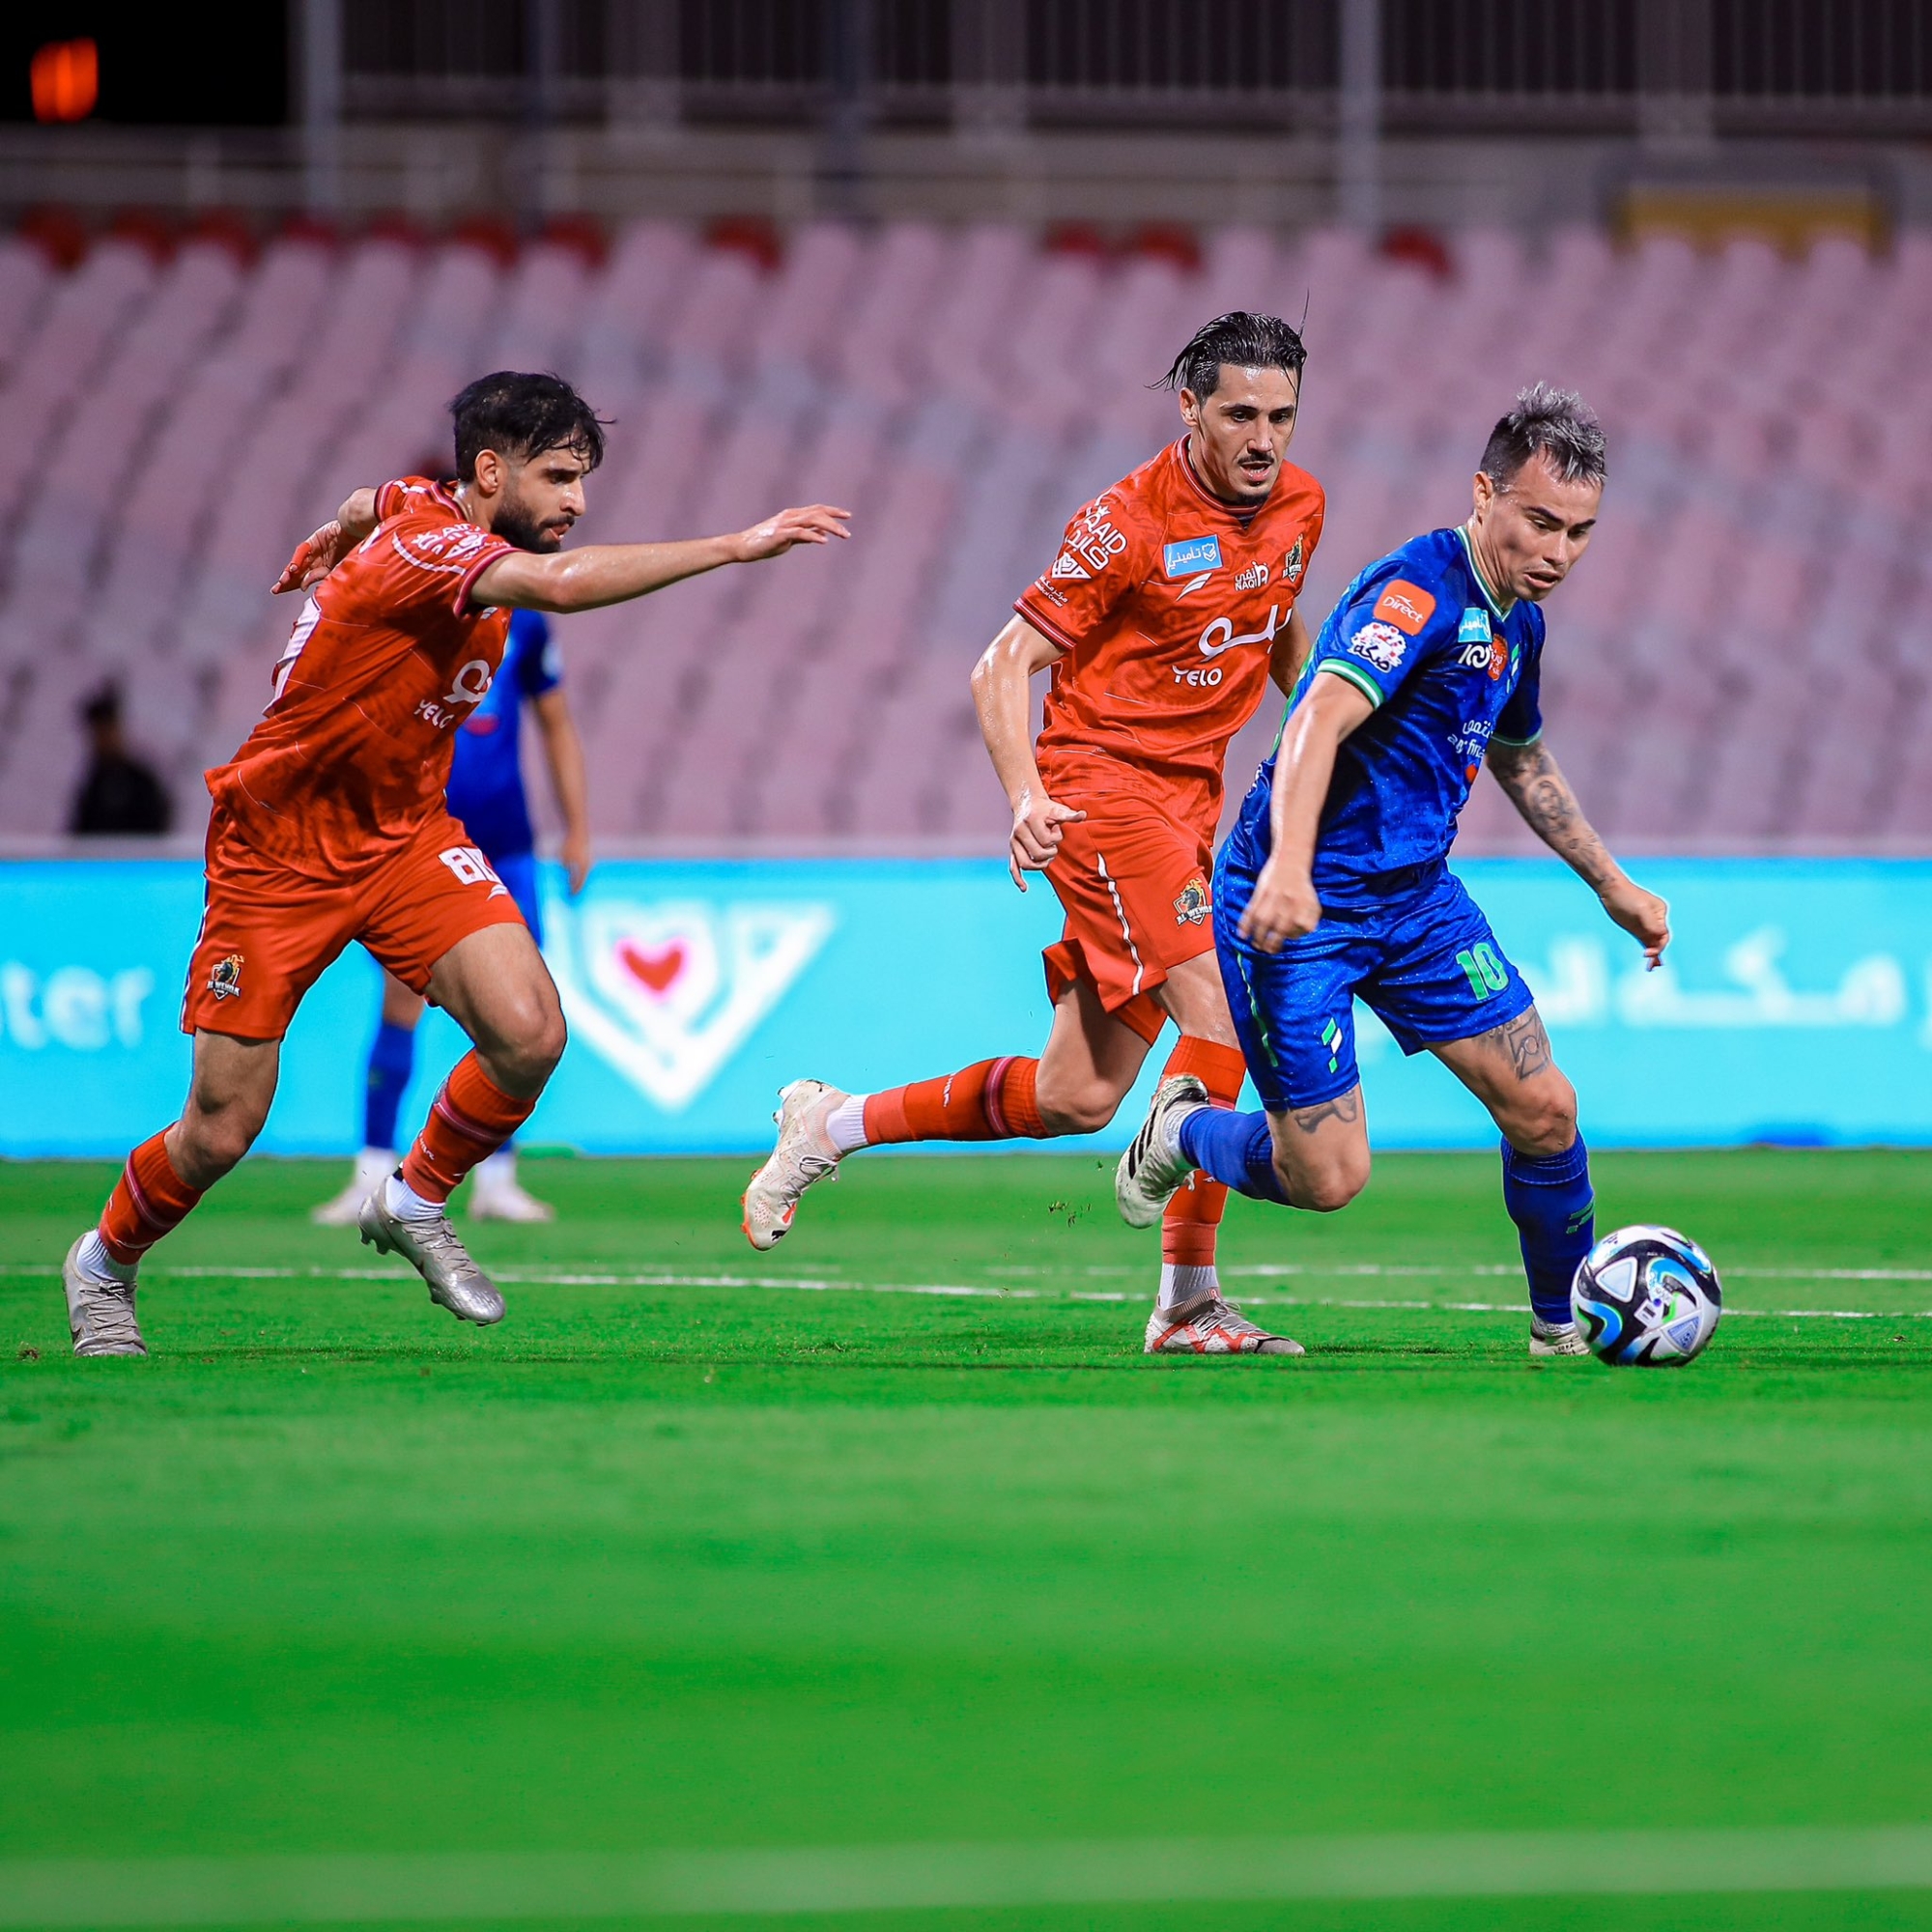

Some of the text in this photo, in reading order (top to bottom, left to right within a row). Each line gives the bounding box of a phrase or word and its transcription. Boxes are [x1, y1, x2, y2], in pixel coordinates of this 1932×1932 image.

[1235, 579, 1258, 591] NAQI
[1382, 595, 1425, 623] Direct
[1172, 665, 1223, 687] YELO
[1456, 943, 1509, 1001] 10
